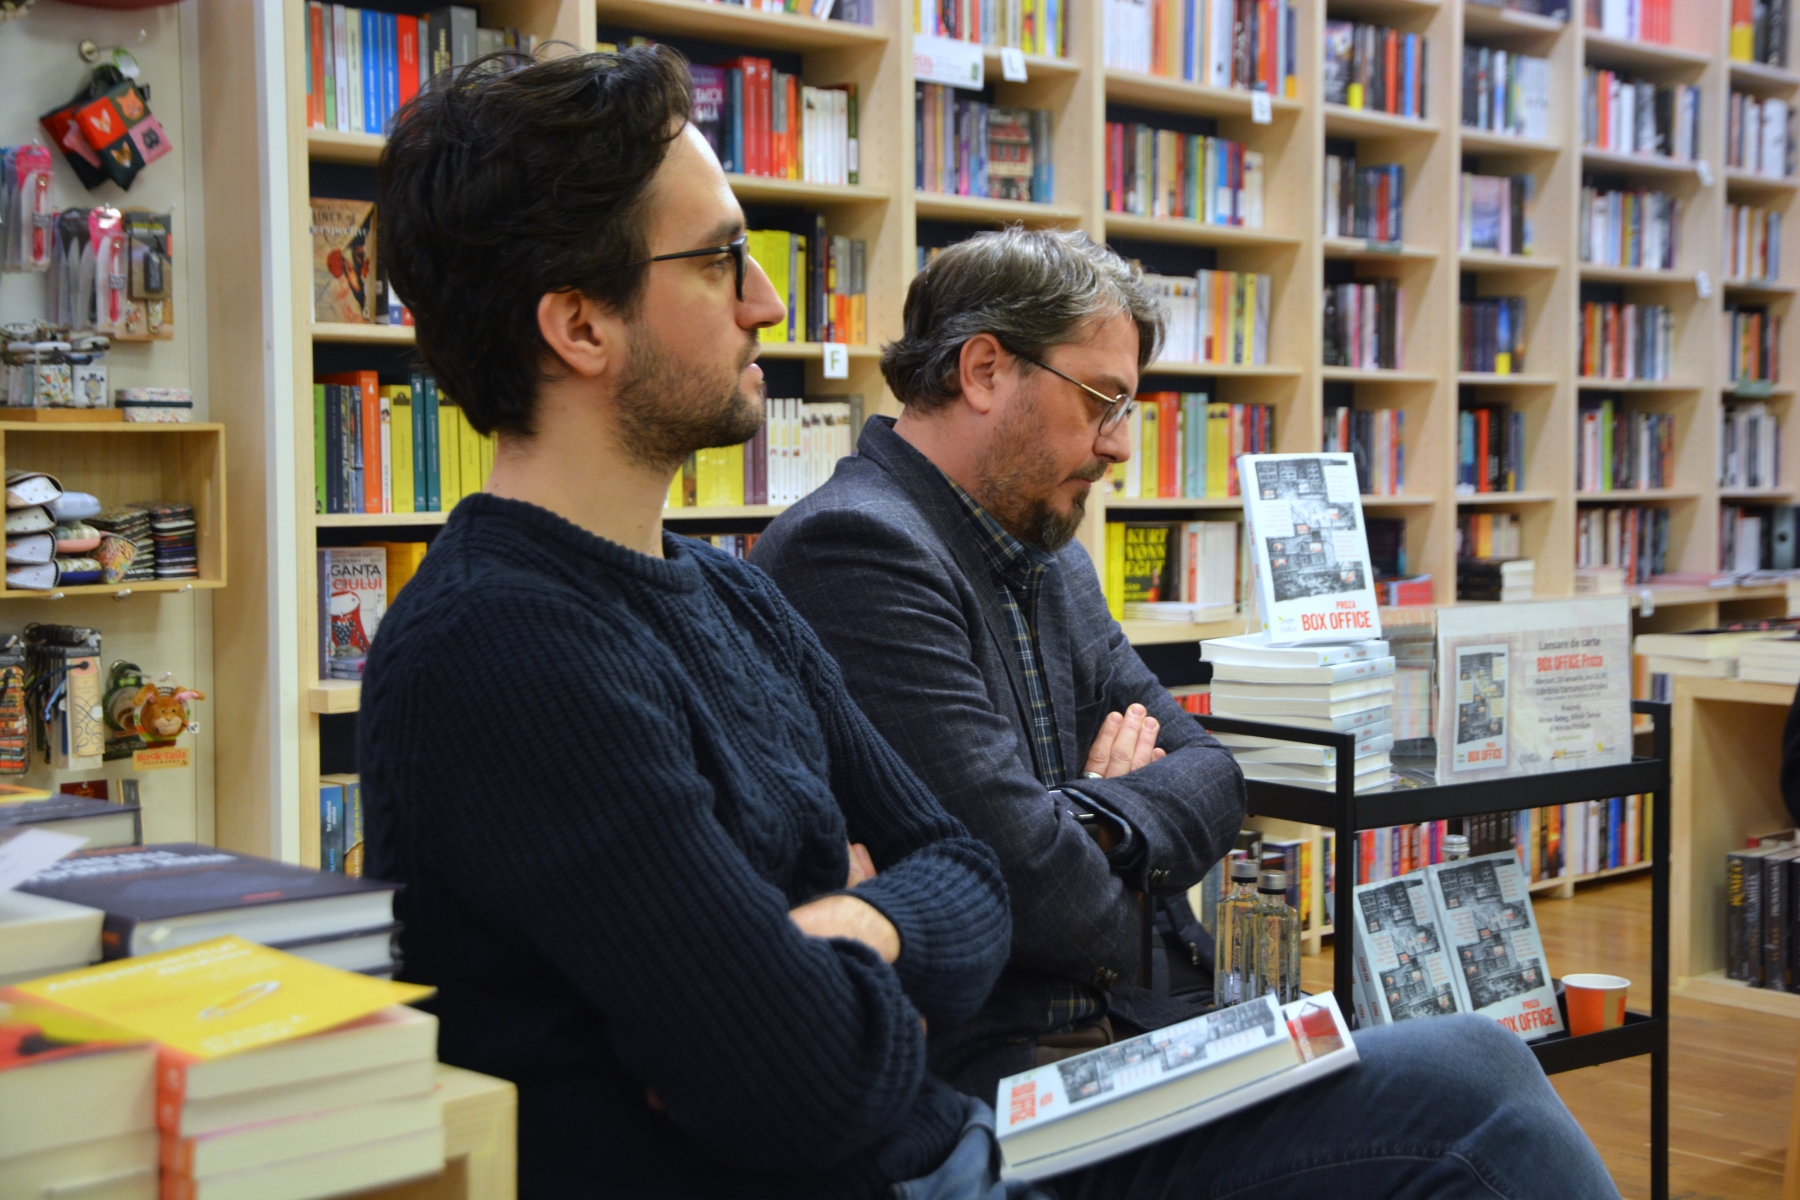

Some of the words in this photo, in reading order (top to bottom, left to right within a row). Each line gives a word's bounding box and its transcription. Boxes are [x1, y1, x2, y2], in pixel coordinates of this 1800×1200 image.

[829, 350, 841, 371] F
[1335, 600, 1356, 609] PROZA
[1301, 613, 1328, 631] BOX
[1329, 610, 1373, 630] OFFICE
[1570, 637, 1580, 648] de
[1582, 637, 1601, 647] carte
[1537, 655, 1553, 672] BOX
[1554, 654, 1580, 670] OFFICE
[1468, 751, 1480, 762] BOX
[1482, 748, 1503, 761] OFFICE
[1518, 1007, 1557, 1031] OFFICE
